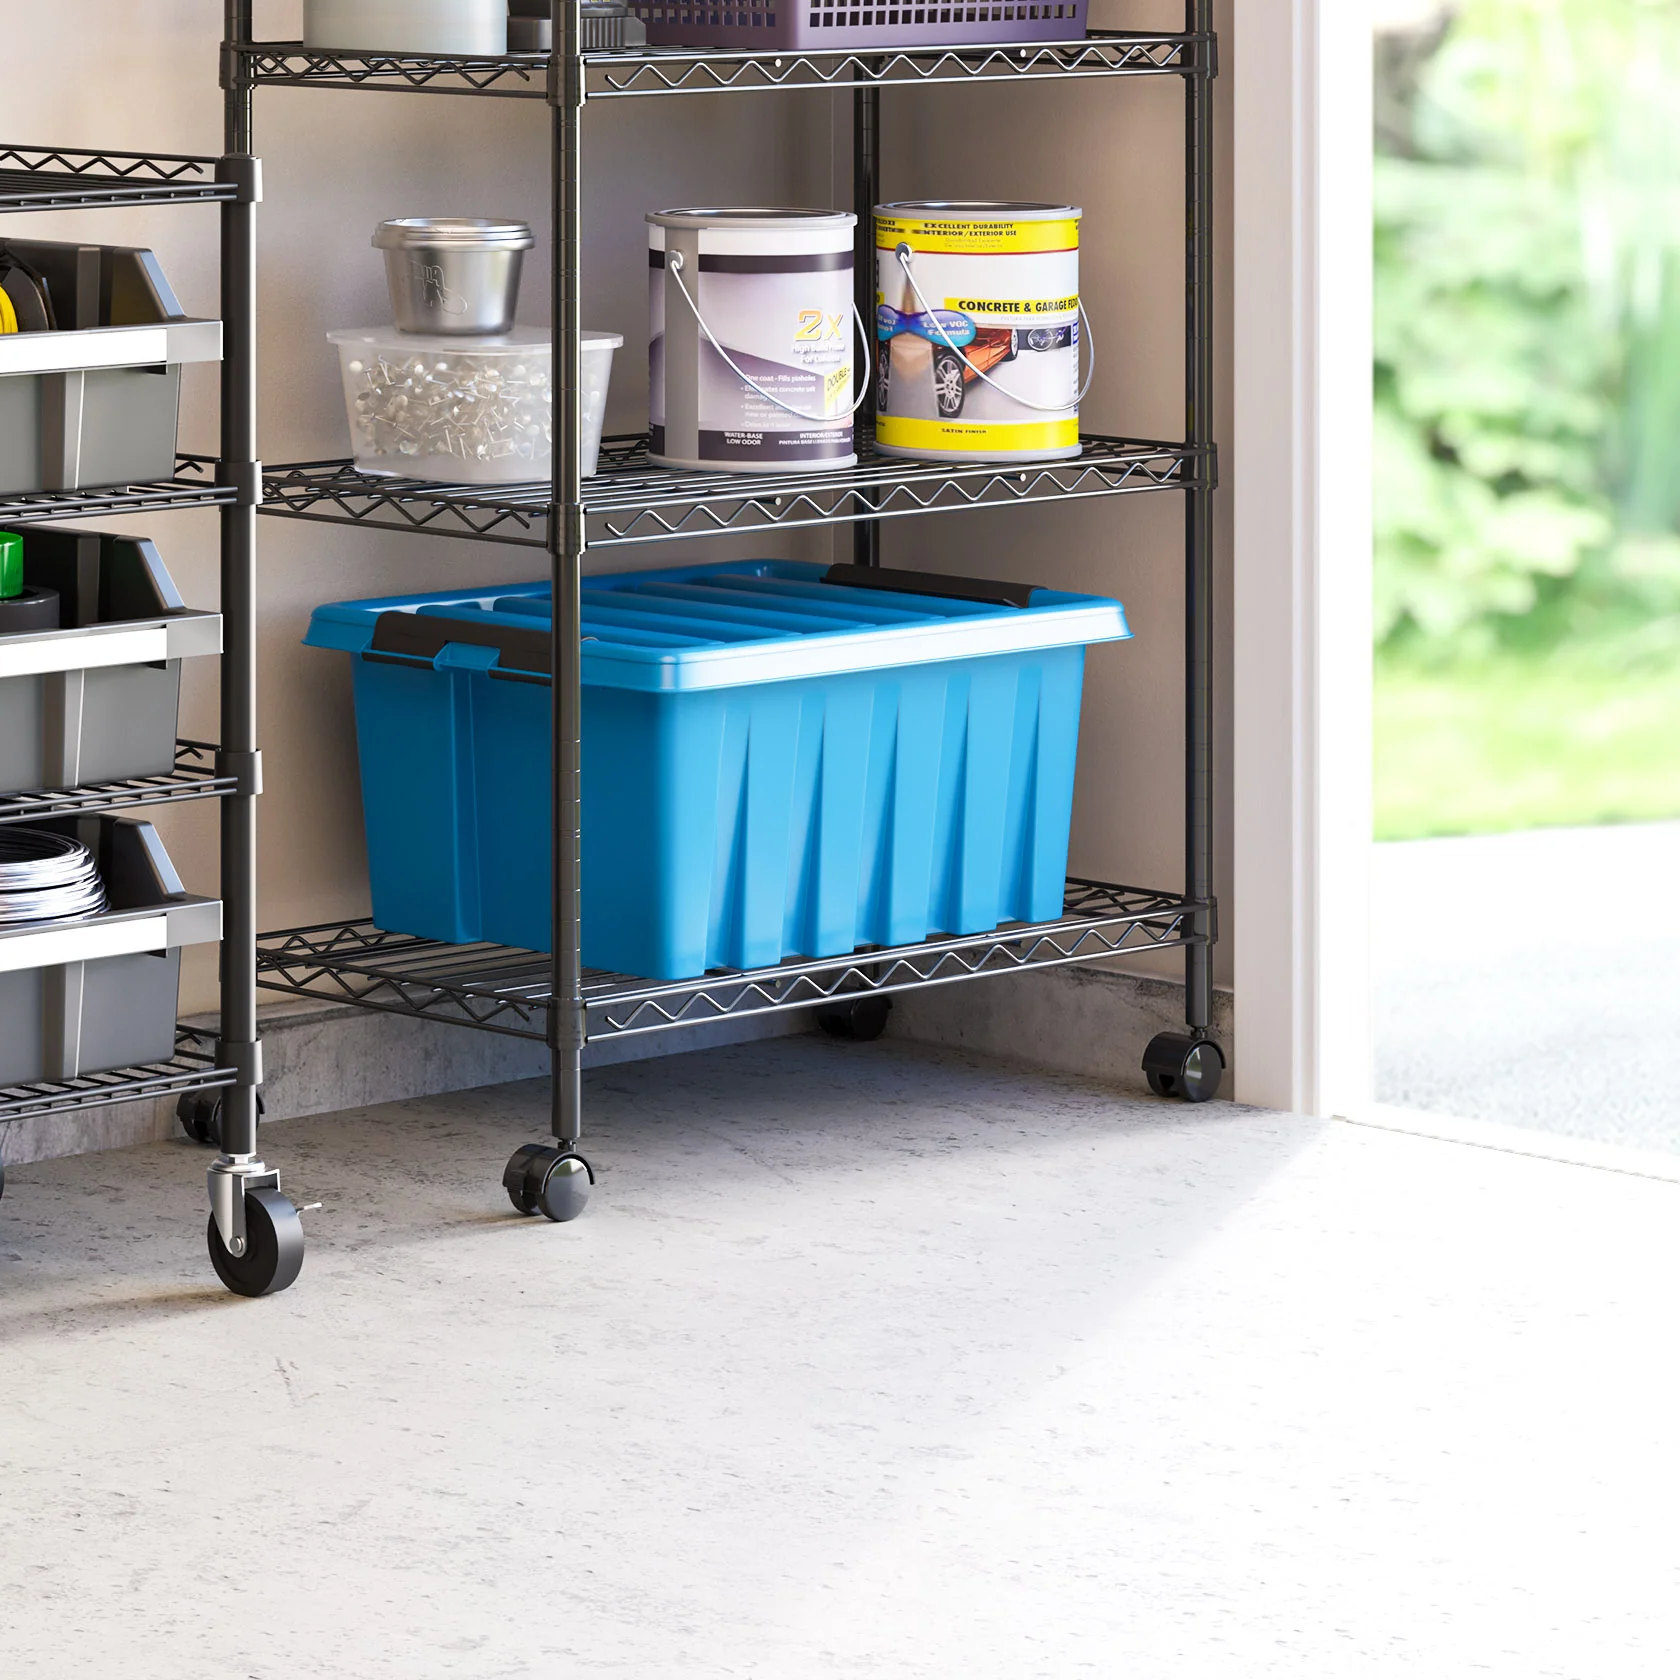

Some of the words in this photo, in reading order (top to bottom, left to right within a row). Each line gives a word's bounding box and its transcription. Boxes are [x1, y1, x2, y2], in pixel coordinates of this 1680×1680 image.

[923, 229, 1004, 237] NTERIOR/EXTERIOR
[958, 300, 1020, 313] CONCRETE
[1023, 301, 1032, 312] &
[1035, 301, 1067, 312] GARAGE
[949, 320, 969, 328] VOC
[724, 431, 763, 440] WATER-BASE
